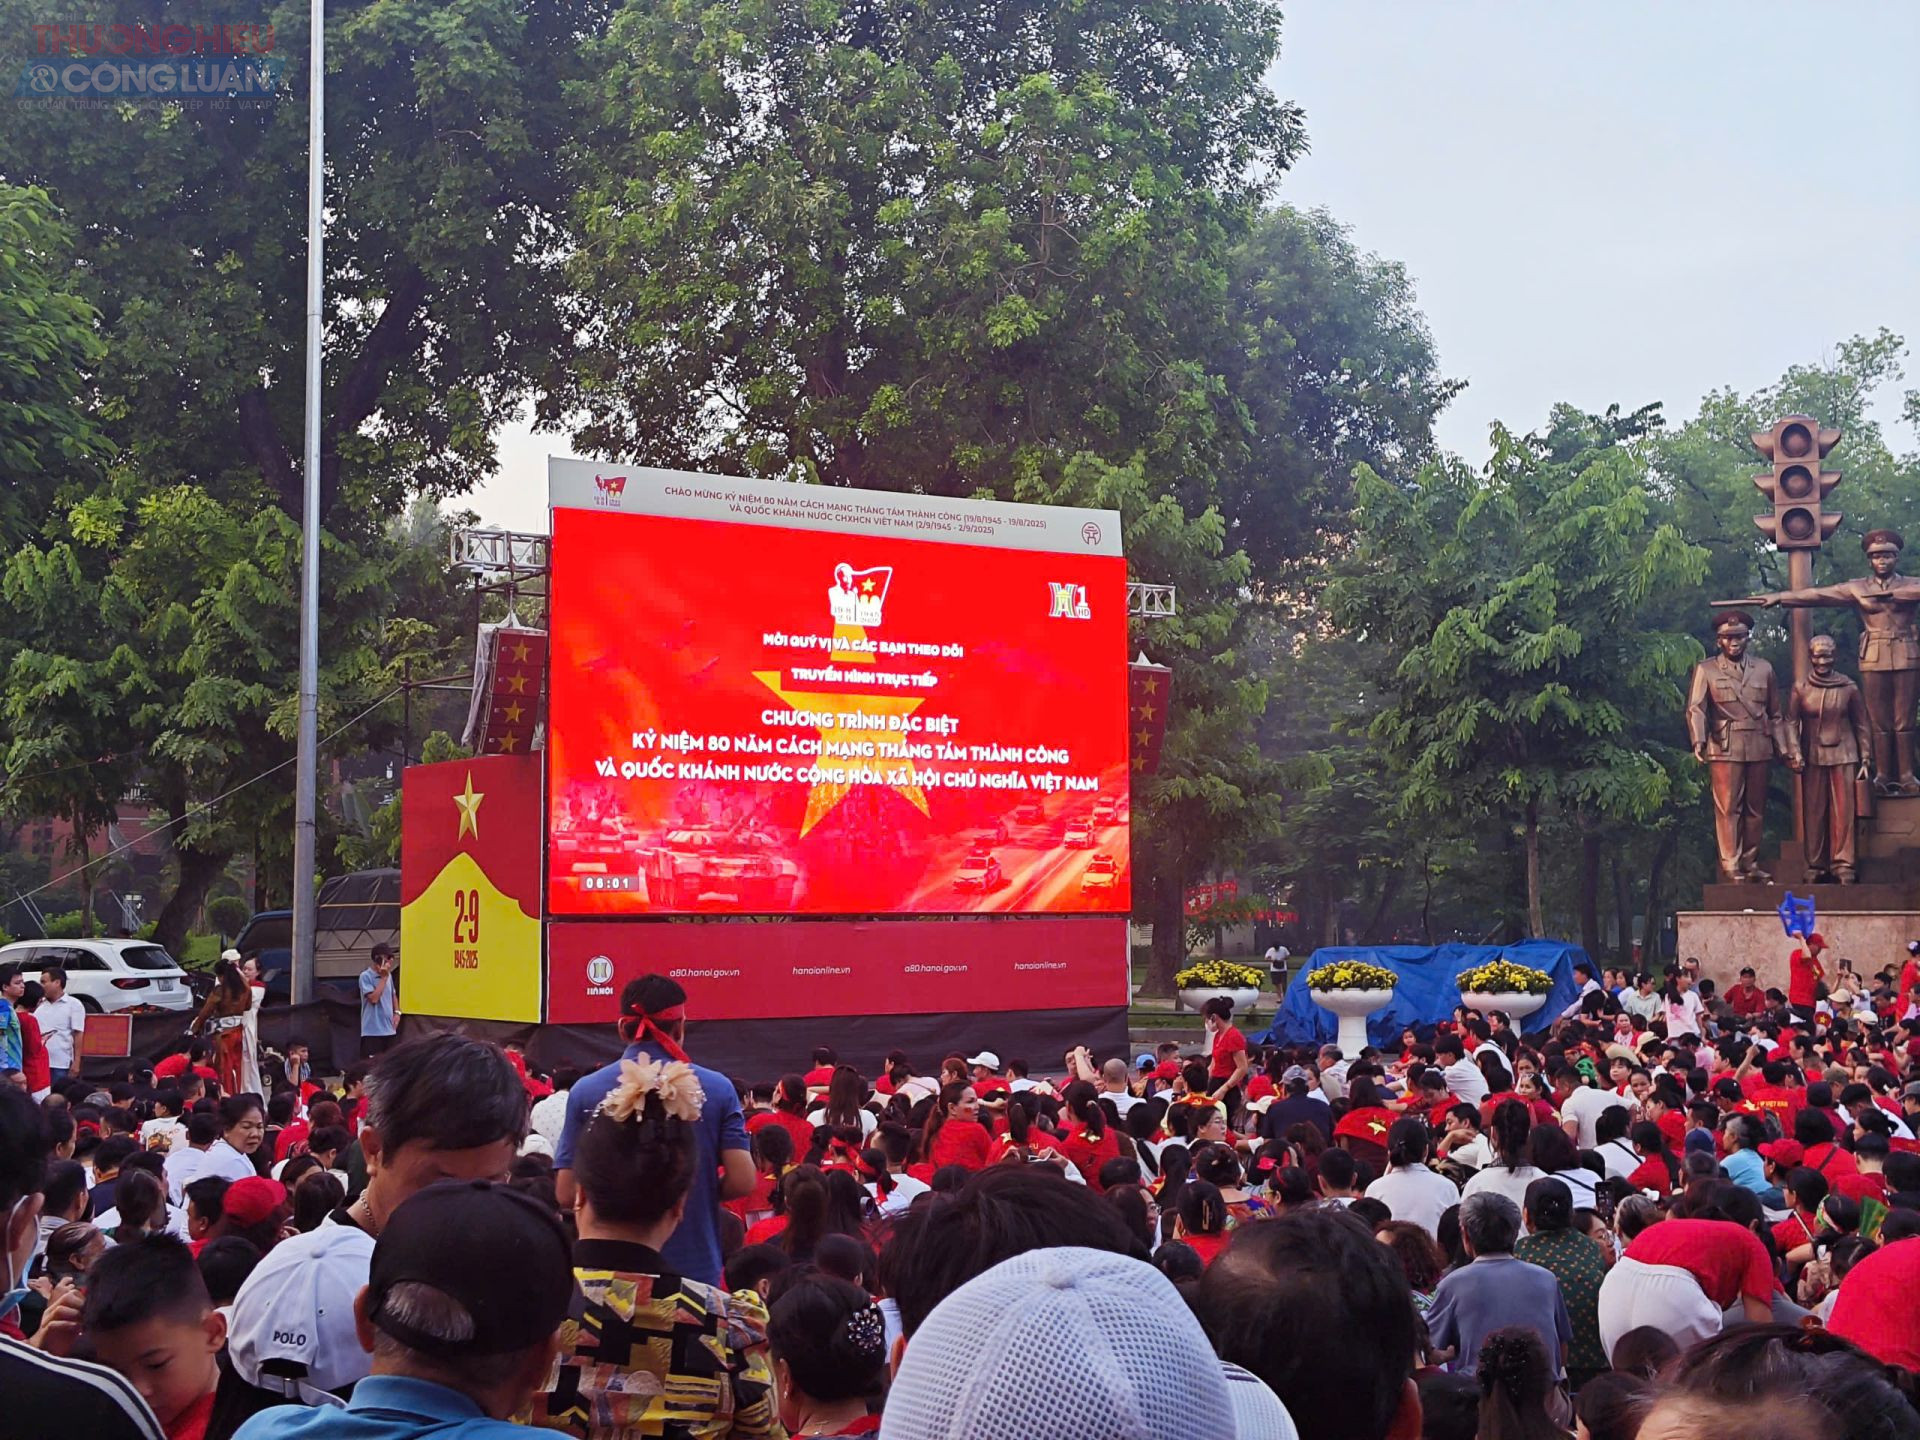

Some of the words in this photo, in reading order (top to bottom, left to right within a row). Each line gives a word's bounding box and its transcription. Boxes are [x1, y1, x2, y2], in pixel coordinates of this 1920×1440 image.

[665, 486, 692, 497] CHÀO
[694, 488, 722, 500] MỪNG
[738, 493, 762, 503] NIỆM
[764, 496, 775, 504] 80
[777, 497, 797, 507] NĂM
[799, 499, 824, 510] CÁCH
[855, 504, 885, 515] THÁNG
[887, 507, 905, 516] TÁM
[907, 508, 936, 519] THÀNH
[938, 511, 961, 521] CÔNG
[729, 503, 742, 513] VÀ
[744, 503, 771, 515] QUỐC
[773, 508, 805, 518] KHÁNH
[835, 514, 871, 524] CHXHCN
[873, 516, 892, 526] VIỆT
[894, 519, 913, 527] NAM
[915, 520, 951, 531] (2/9/1945
[958, 523, 995, 535] 2/9/2025)
[763, 632, 788, 646] MỜI
[790, 634, 817, 648] QUÝ
[817, 637, 832, 653] VỊ
[833, 636, 851, 651] VÀ
[852, 637, 878, 653] CÁC
[880, 641, 906, 656] BẠN
[907, 643, 940, 656] THEO
[876, 672, 910, 688] TRỰC
[911, 670, 938, 687] TIẾP
[761, 709, 834, 728] CHƯƠNG
[837, 708, 885, 730] TRÌNH
[889, 713, 922, 735] ĐẶC
[925, 714, 959, 737] BIỆT
[632, 727, 657, 749] KỶ
[660, 730, 704, 755] NIỆM
[708, 735, 731, 752] 80
[734, 734, 772, 753] NĂM
[776, 734, 822, 755] CÁCH
[826, 740, 875, 760] MẠNG
[878, 741, 932, 760] THÁNG
[936, 741, 967, 761] TÁM
[969, 742, 1023, 763] THÀNH
[1025, 745, 1069, 765] CÔNG
[594, 756, 618, 777] VÀ
[620, 755, 675, 780] QUỐC
[678, 759, 740, 781] KHÁNH
[744, 762, 793, 782] NƯỚC
[796, 763, 845, 787] CỘNG
[848, 764, 883, 785] HÒA
[886, 766, 909, 786] XÃ
[911, 767, 941, 790] HỘI
[943, 768, 977, 788] CHỦ
[979, 770, 1028, 789] NGHĨA
[1030, 771, 1063, 794] VIỆT
[1065, 775, 1099, 792] NAM
[454, 889, 480, 943] 2-9
[669, 967, 740, 979] a80.hanoi.gov.vn
[792, 965, 851, 975] hanoionline.vn
[904, 964, 968, 974] a80.hanoi.gov.vn
[1014, 961, 1067, 970] hanoionline.vn
[272, 1330, 307, 1346] POLO
